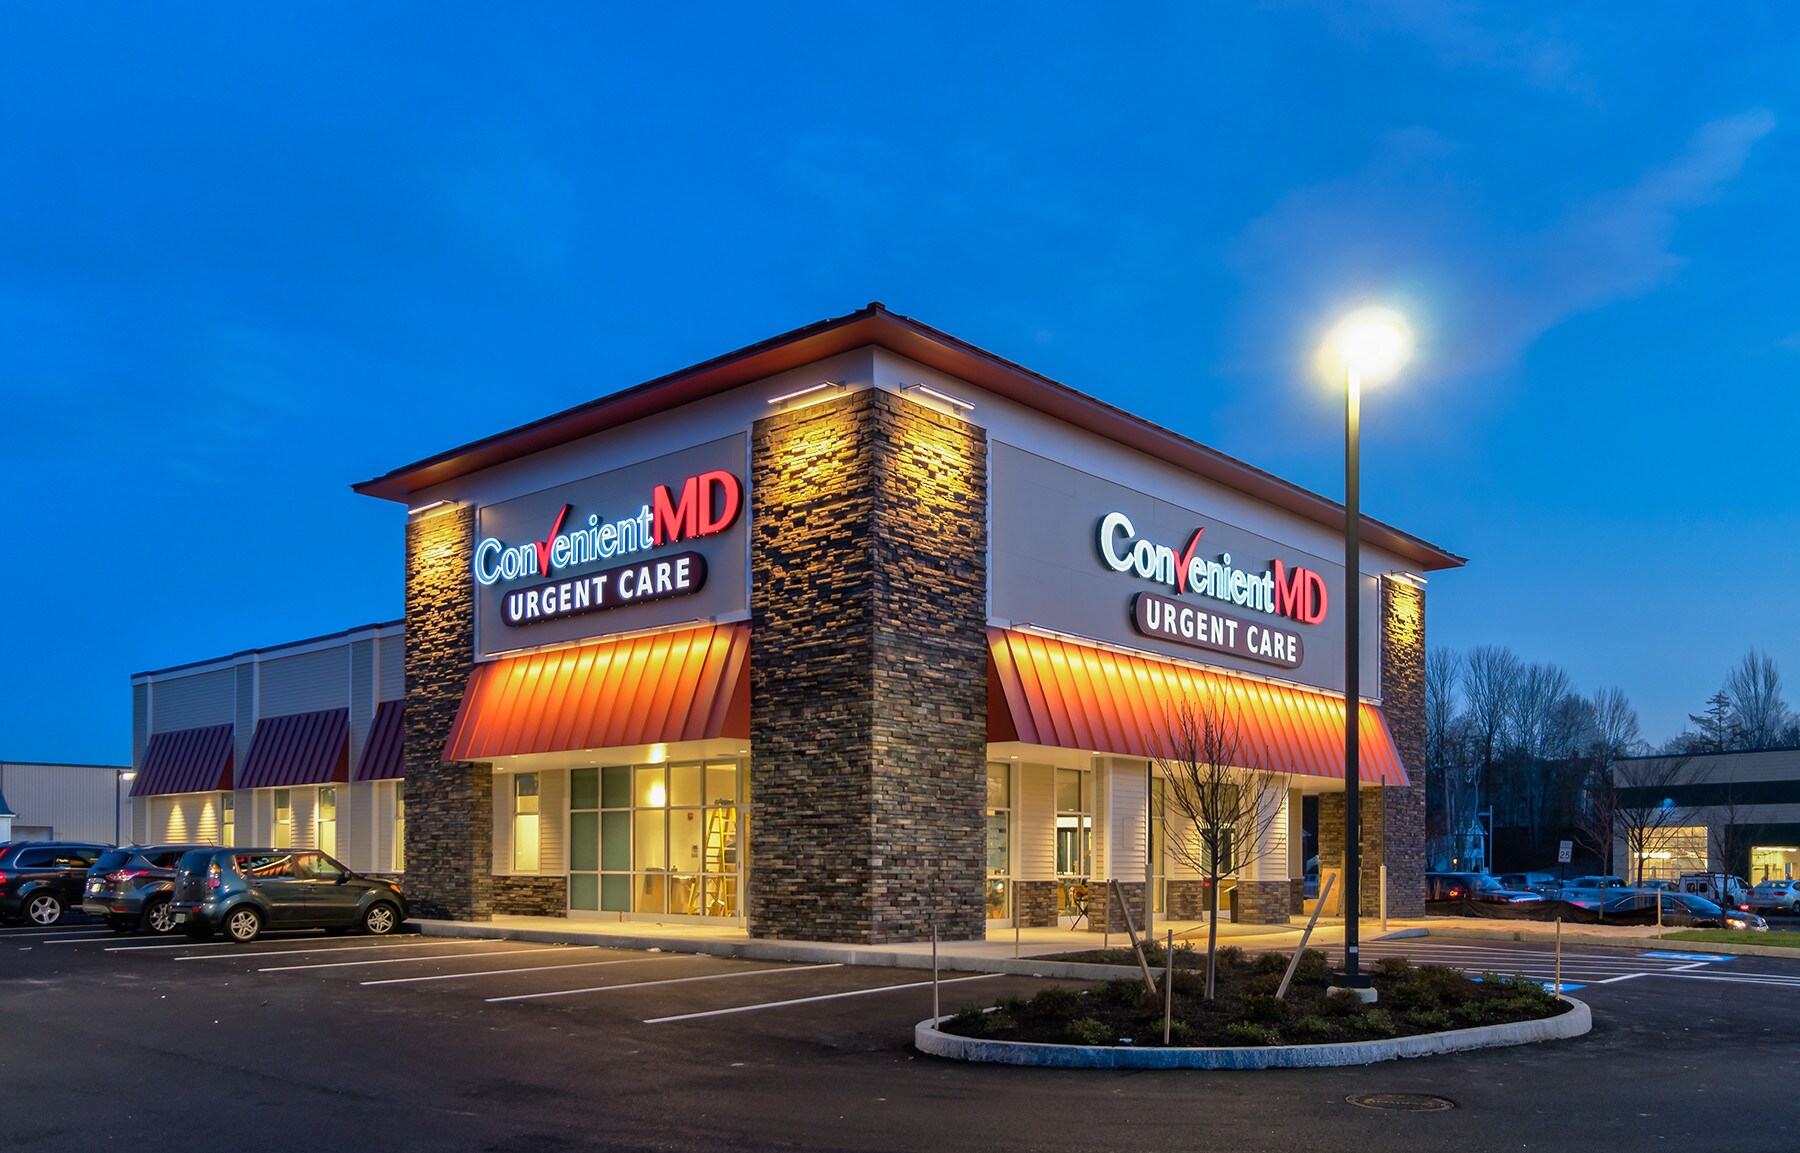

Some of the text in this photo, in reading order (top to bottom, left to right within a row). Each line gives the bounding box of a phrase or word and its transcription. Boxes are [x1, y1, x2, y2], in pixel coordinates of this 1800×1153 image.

[475, 470, 742, 585] ConvenientMD
[509, 557, 691, 621] URGENT CARE
[1099, 511, 1329, 625] ConvenientMD
[1145, 598, 1297, 662] URGENT CARE
[1560, 851, 1570, 860] 25
